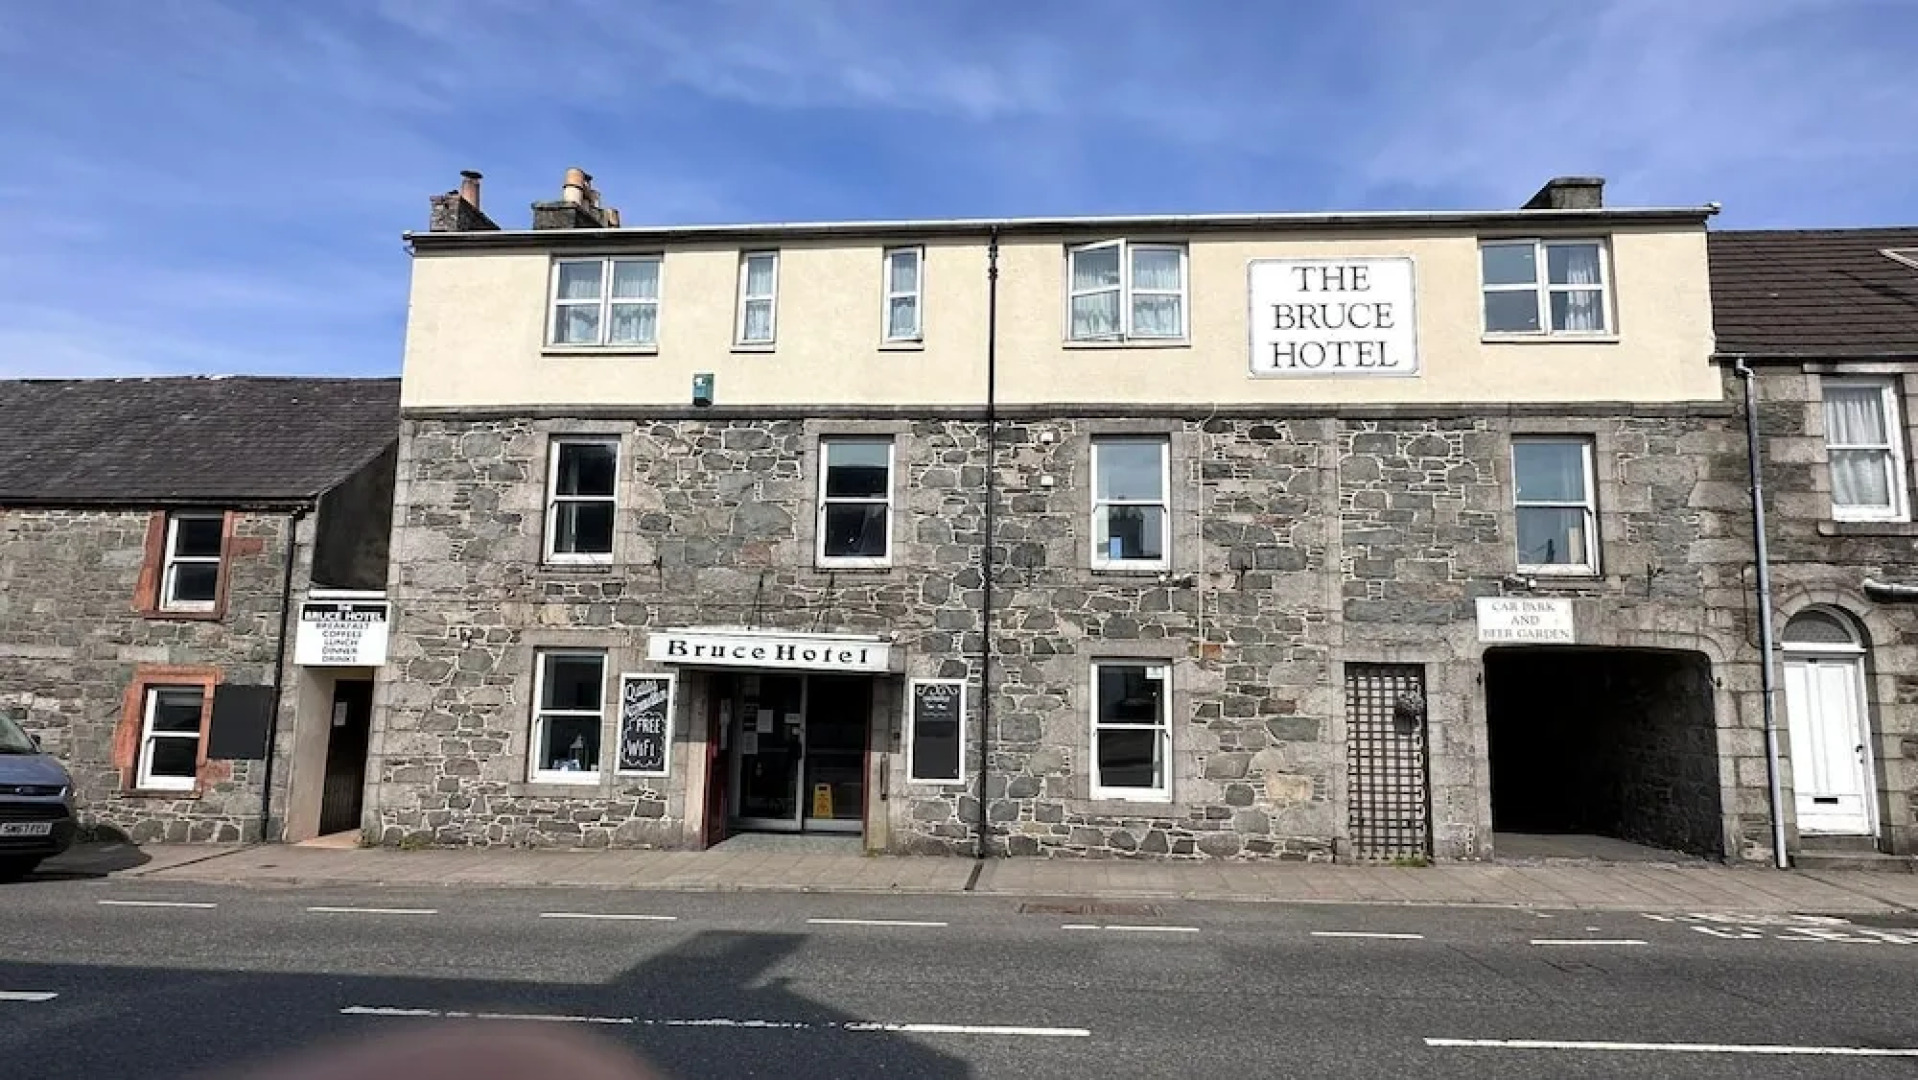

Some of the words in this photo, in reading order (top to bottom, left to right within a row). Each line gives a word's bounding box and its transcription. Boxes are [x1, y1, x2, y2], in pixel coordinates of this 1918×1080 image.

[1291, 265, 1371, 292] THE
[1270, 302, 1395, 330] BRUCE
[1269, 340, 1399, 368] HOTEL
[1511, 615, 1539, 625] AND
[668, 640, 766, 659] Bruce
[775, 643, 868, 664] Hotel
[636, 718, 661, 734] FREE
